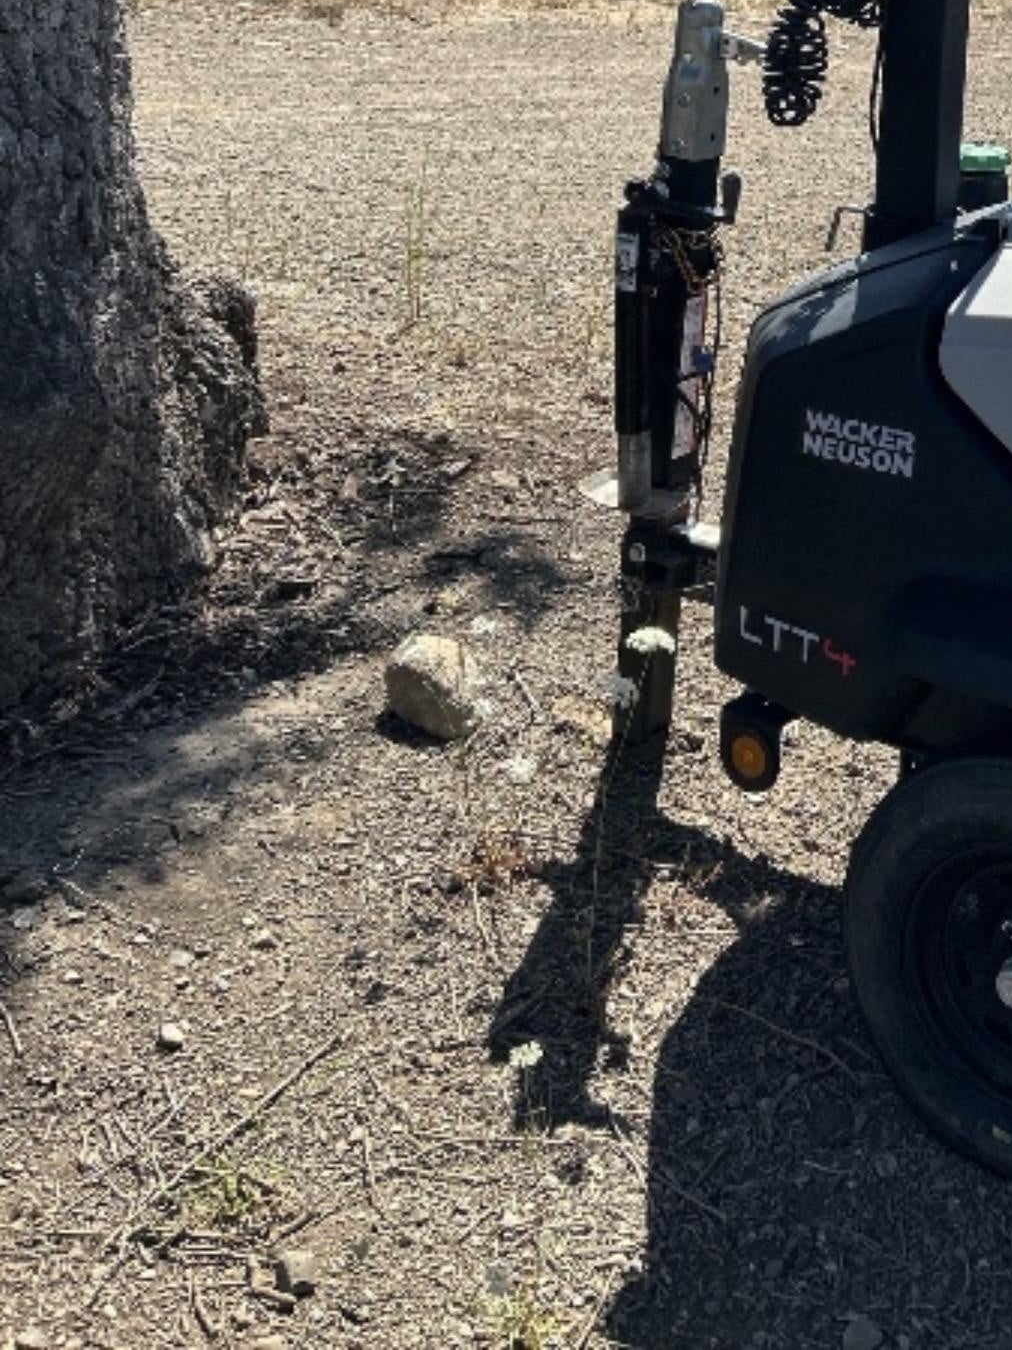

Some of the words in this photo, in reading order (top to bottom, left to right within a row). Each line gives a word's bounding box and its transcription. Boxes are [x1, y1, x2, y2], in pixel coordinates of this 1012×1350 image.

[805, 408, 916, 454] WACKER
[802, 432, 914, 480] NEUSON
[739, 605, 856, 676] LTT4
